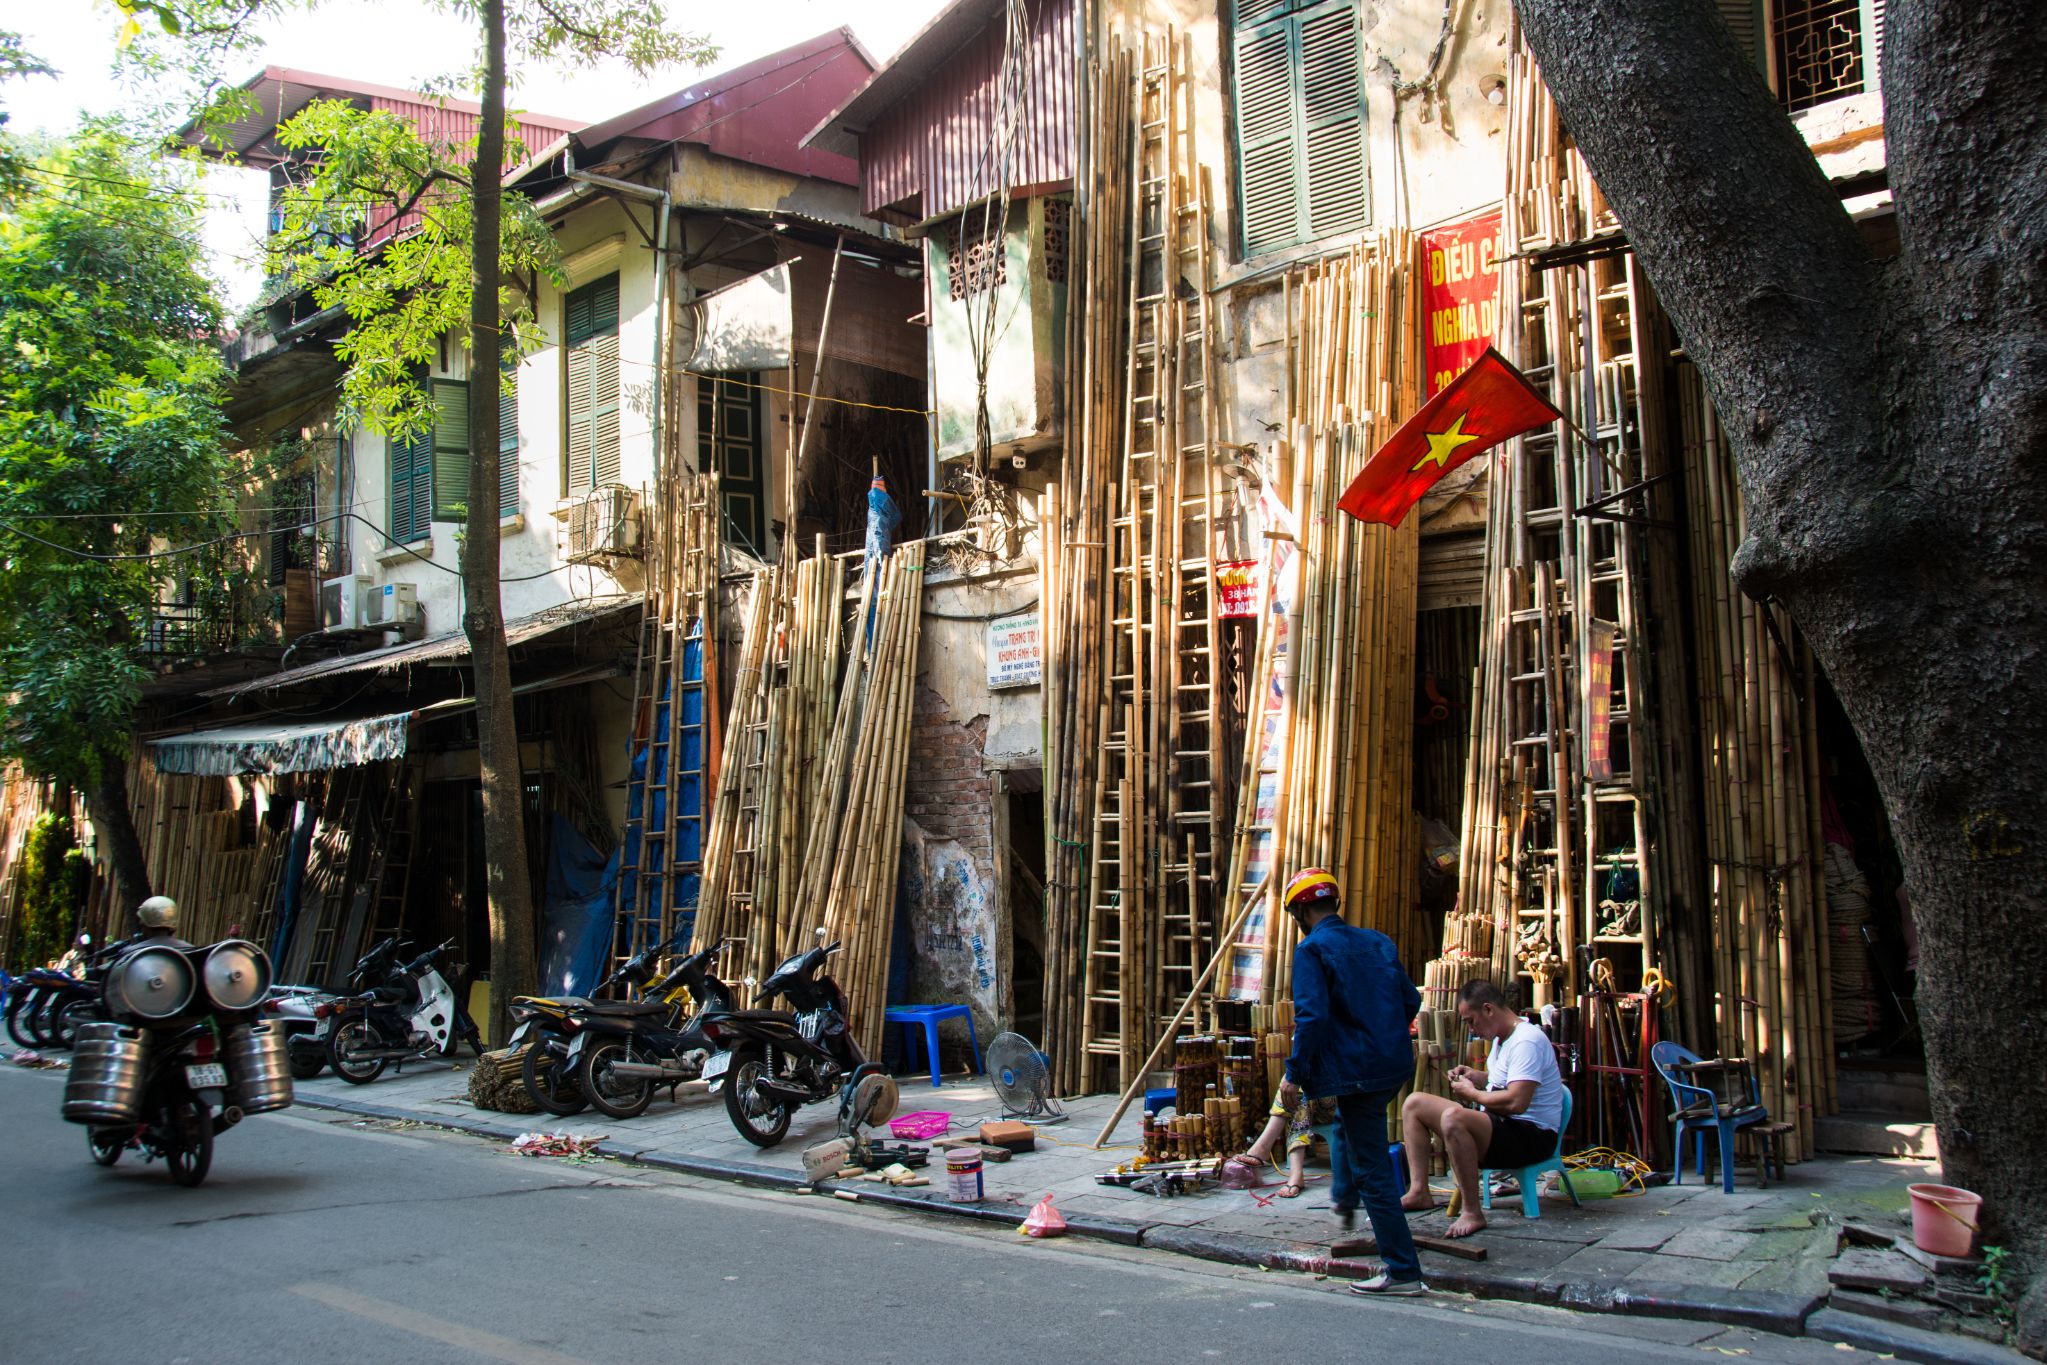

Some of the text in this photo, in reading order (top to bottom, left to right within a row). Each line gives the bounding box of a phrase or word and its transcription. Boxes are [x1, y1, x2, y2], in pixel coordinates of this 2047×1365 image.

[1431, 232, 1474, 287] ĐIẾU
[1432, 297, 1478, 347] NGHĨA
[1009, 631, 1026, 646] TRANG
[998, 649, 1016, 663] KHUNG
